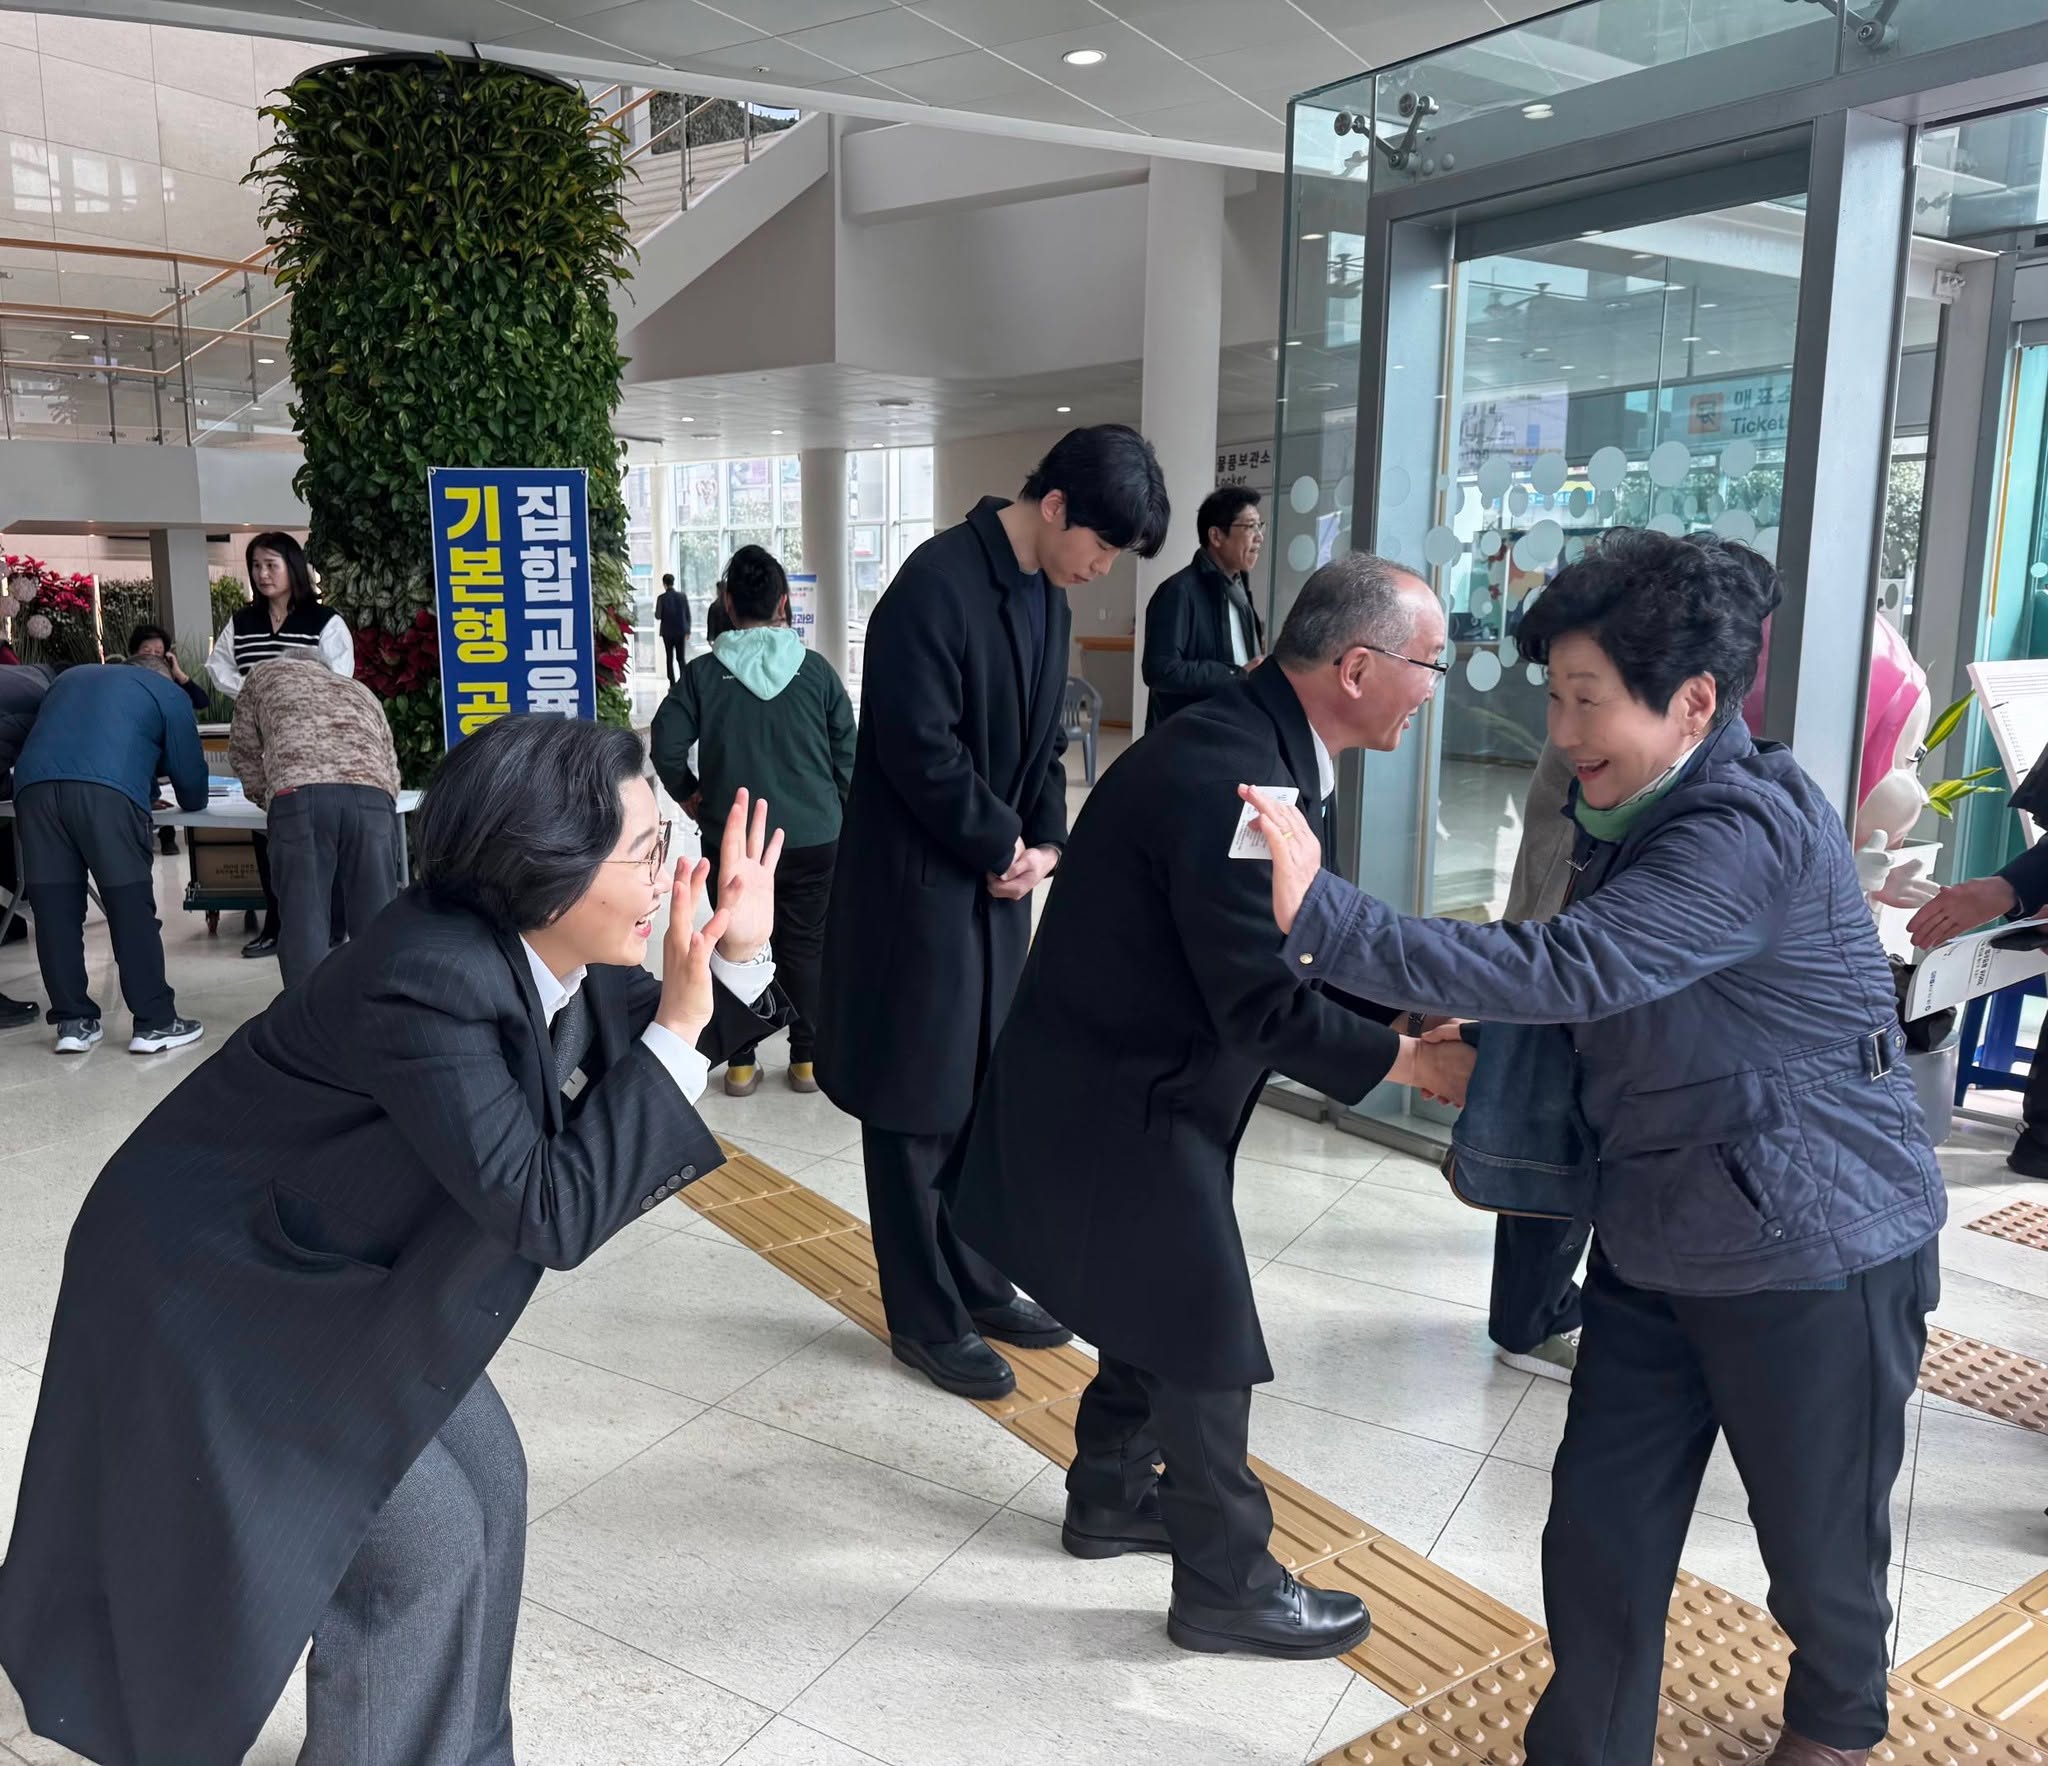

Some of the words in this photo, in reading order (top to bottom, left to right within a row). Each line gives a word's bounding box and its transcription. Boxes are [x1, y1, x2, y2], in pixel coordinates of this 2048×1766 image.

[1217, 449, 1271, 473] 물품보관소
[1731, 414, 1784, 434] Ticket
[444, 486, 508, 663] 기본형
[517, 486, 580, 719] 집합교육
